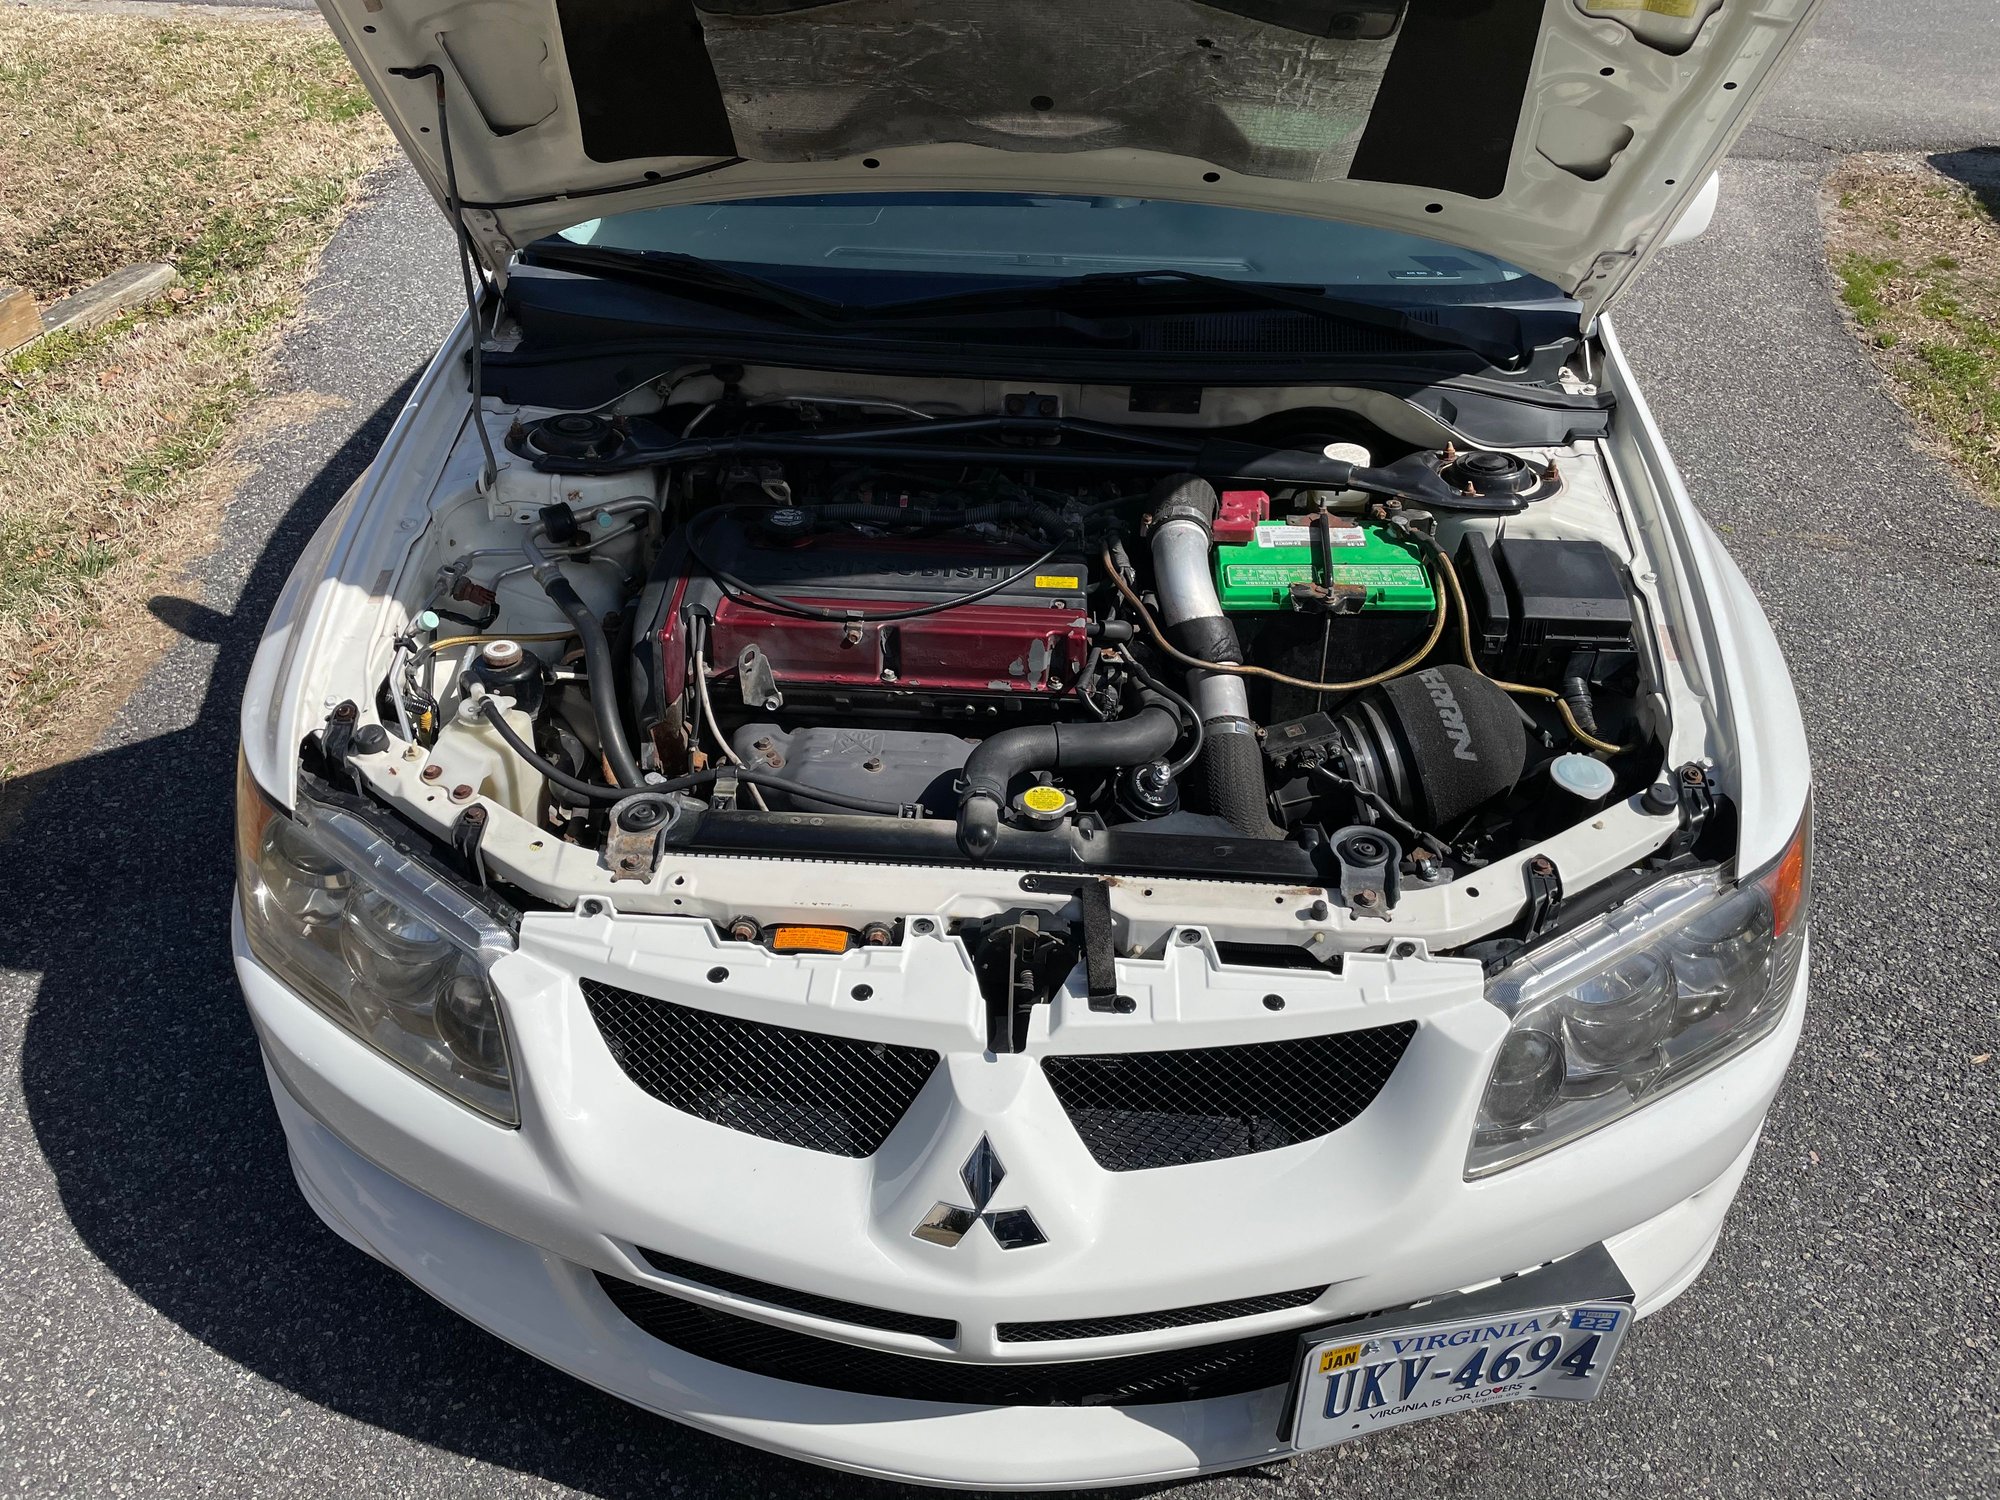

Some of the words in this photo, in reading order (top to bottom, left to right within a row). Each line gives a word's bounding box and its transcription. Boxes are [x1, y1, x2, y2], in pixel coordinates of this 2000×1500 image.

[1391, 1318, 1542, 1354] VIRGINIA
[1578, 1317, 1613, 1330] 22
[1323, 1352, 1357, 1371] JAN
[1323, 1334, 1602, 1420] UKV-4694
[1369, 1403, 1428, 1420] VIRGINIA
[1431, 1399, 1442, 1407] IS
[1445, 1394, 1472, 1404] FOR
